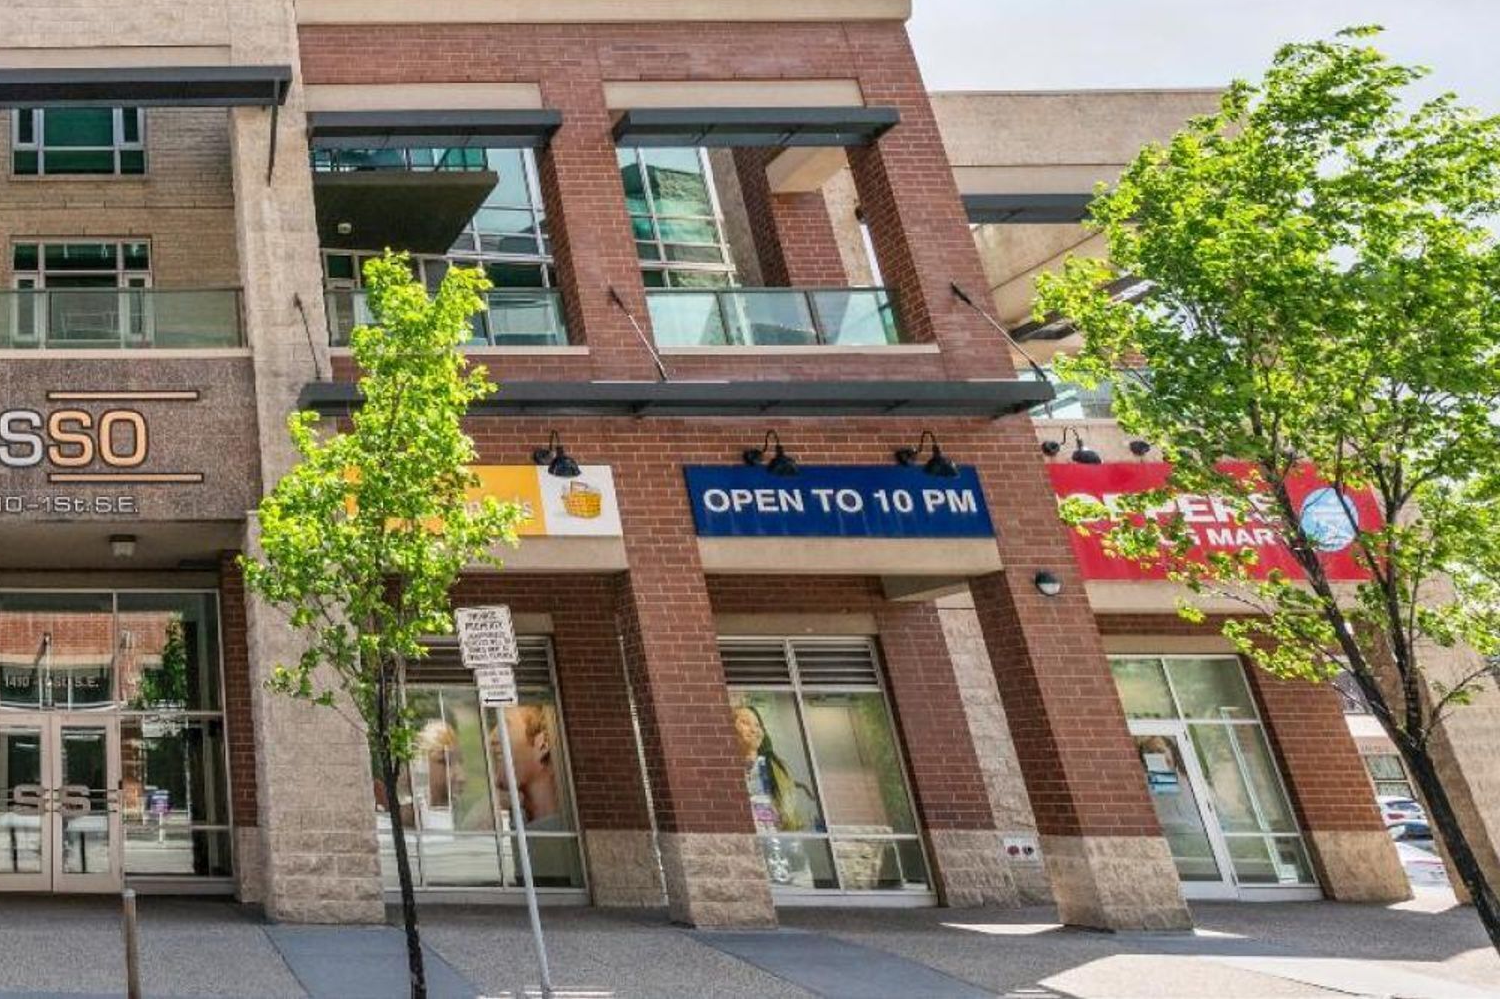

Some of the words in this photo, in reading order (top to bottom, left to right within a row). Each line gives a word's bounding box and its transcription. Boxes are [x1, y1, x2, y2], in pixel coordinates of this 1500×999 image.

[703, 489, 804, 513] OPEN
[811, 489, 863, 513] TO
[873, 489, 913, 513] 10
[922, 489, 977, 513] PM
[1206, 528, 1287, 546] MAR
